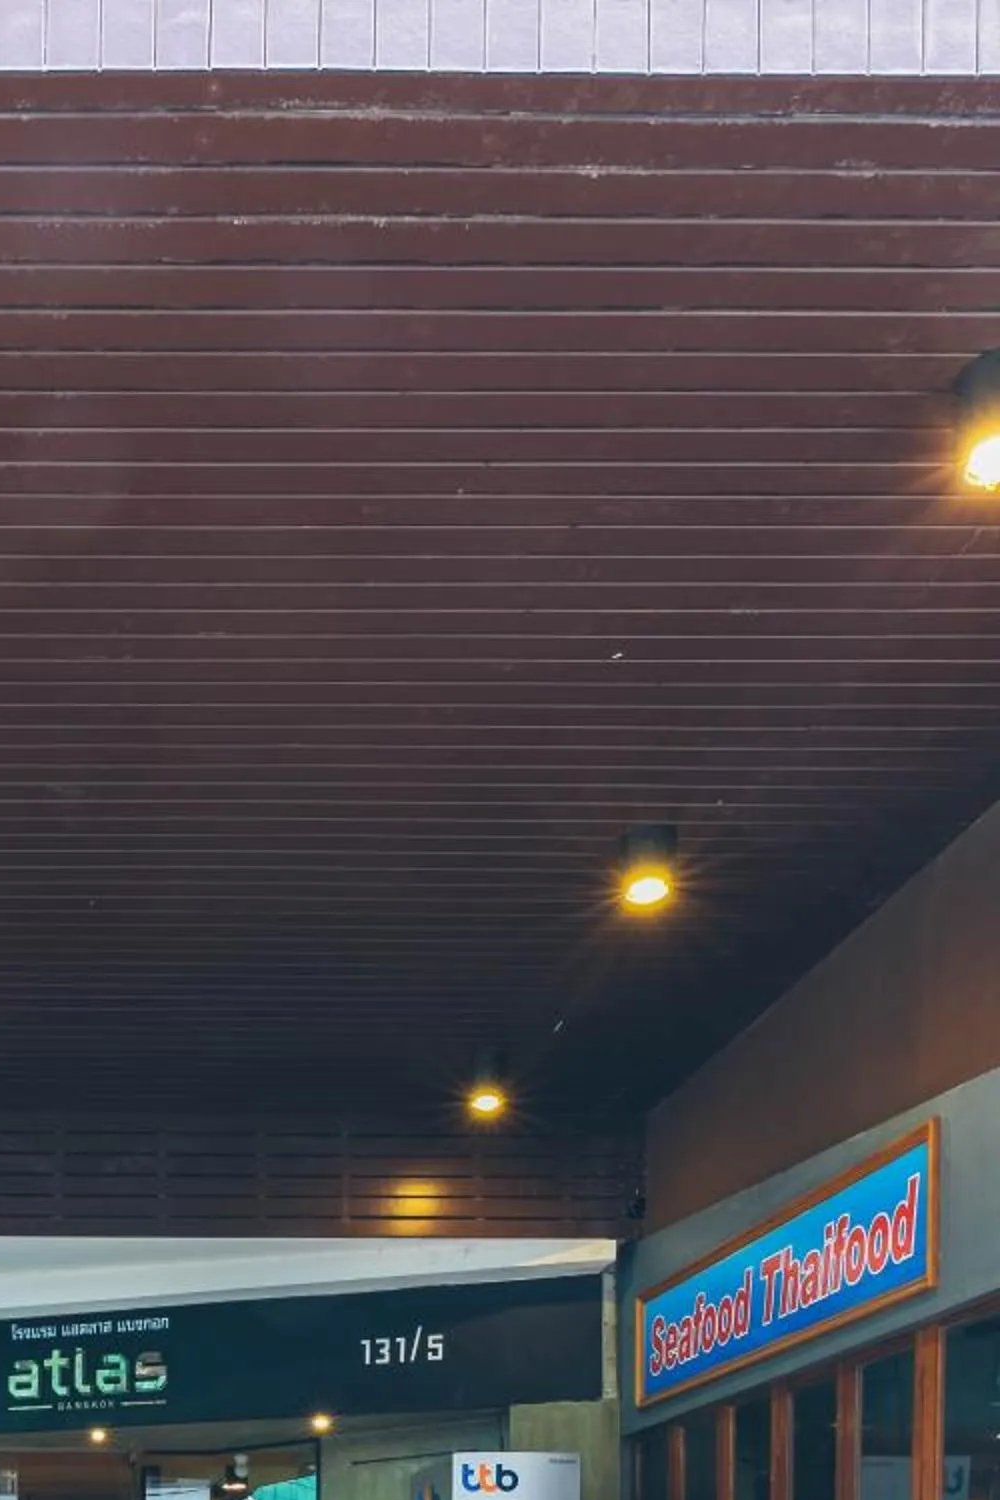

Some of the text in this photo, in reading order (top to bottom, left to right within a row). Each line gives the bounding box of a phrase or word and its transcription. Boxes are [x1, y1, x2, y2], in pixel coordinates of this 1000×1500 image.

[650, 1172, 920, 1376] Seafood Thaifood
[360, 1325, 444, 1365] 131/5
[7, 1347, 168, 1399] atlas
[461, 1463, 519, 1493] ttb
